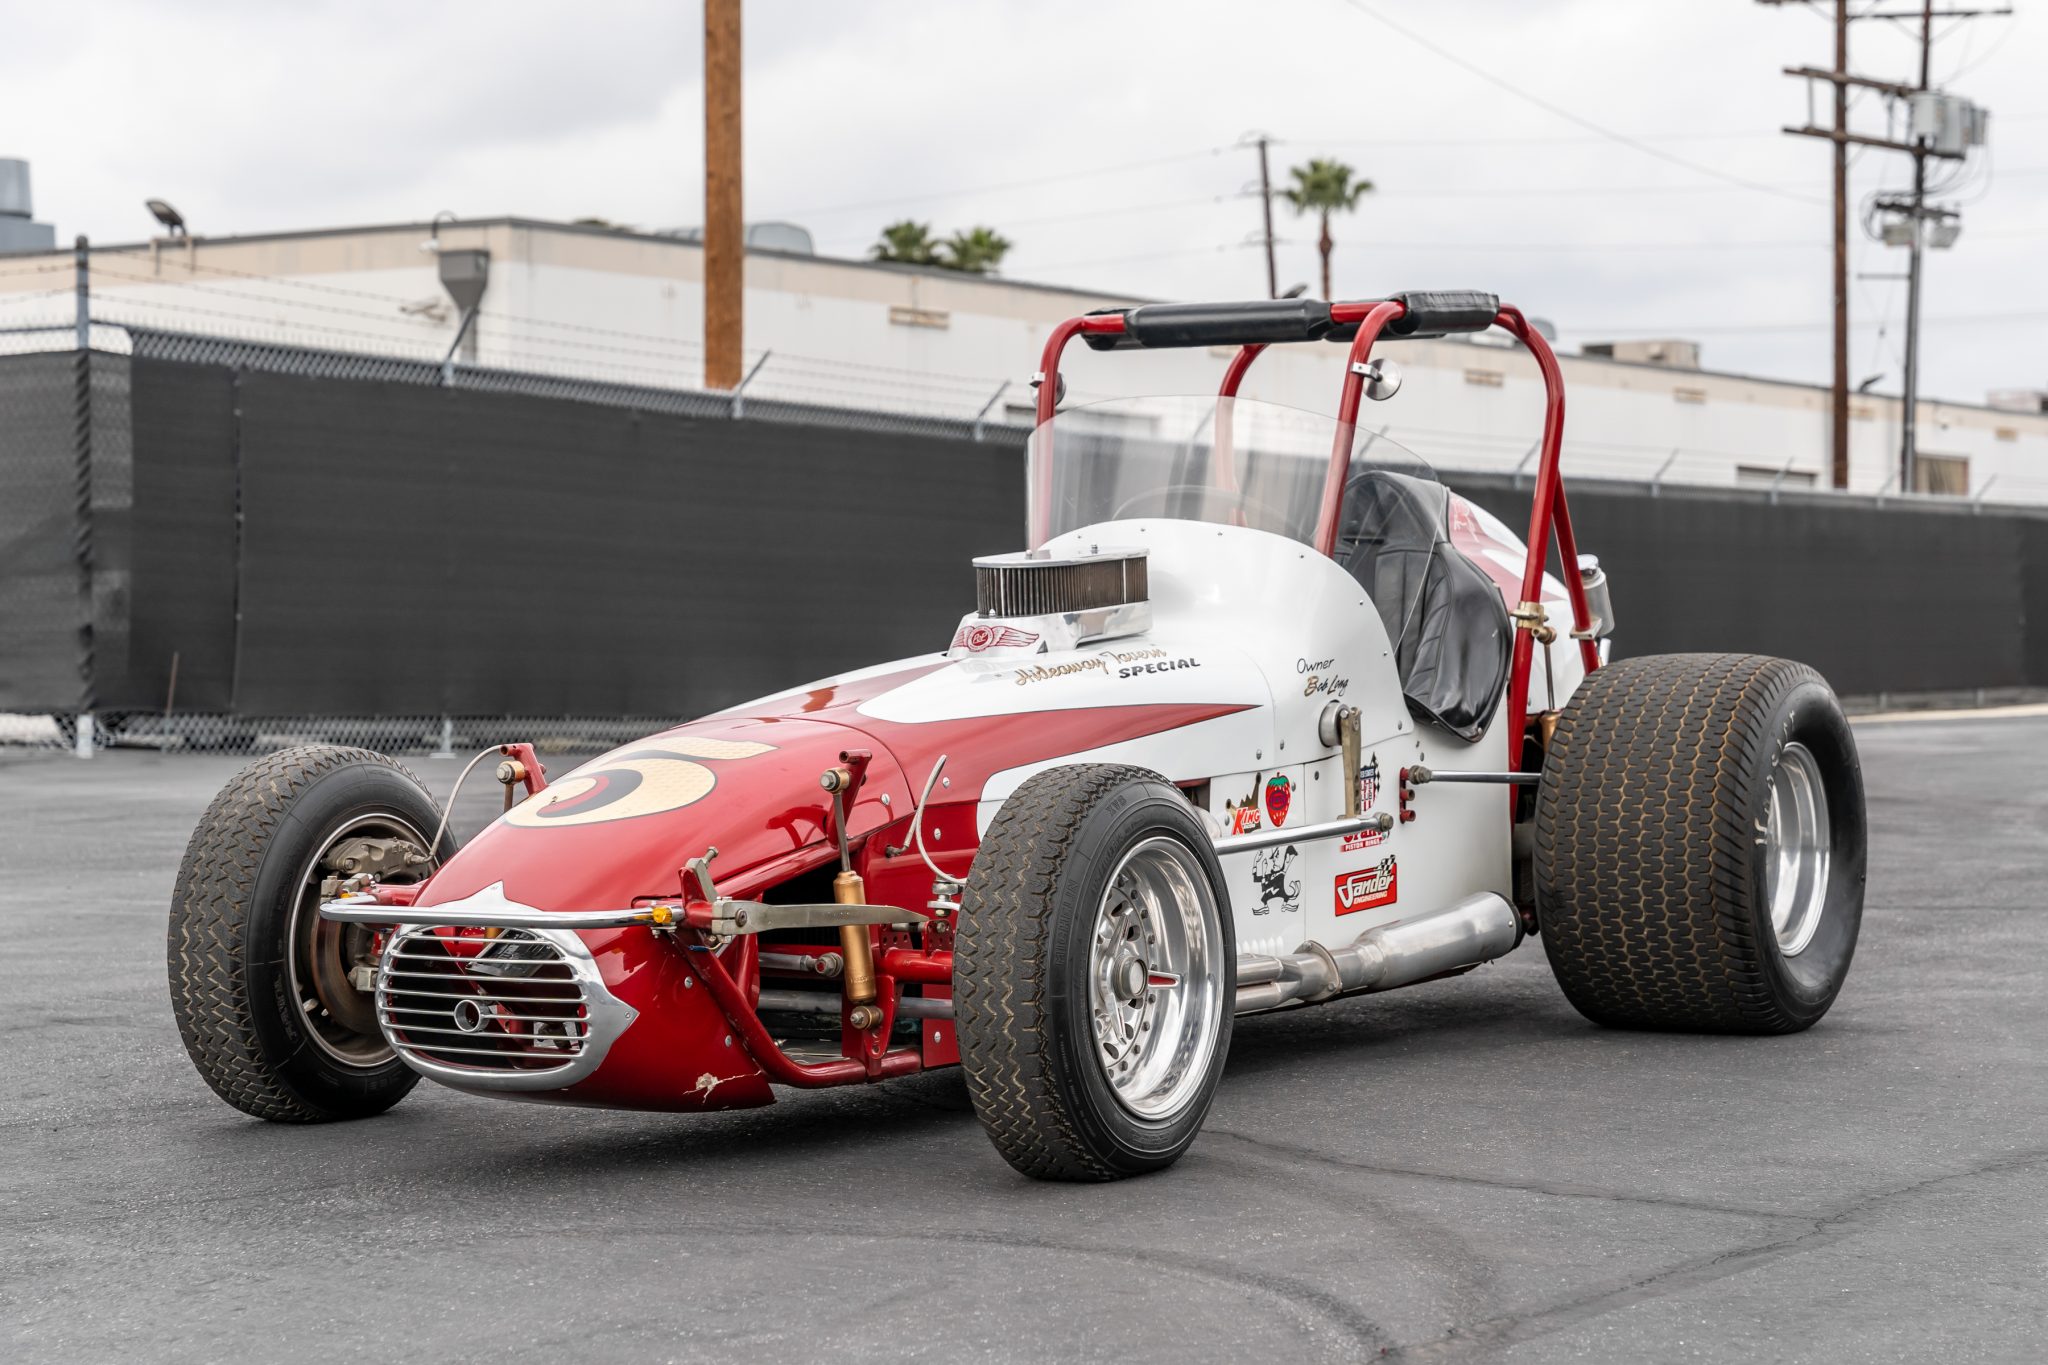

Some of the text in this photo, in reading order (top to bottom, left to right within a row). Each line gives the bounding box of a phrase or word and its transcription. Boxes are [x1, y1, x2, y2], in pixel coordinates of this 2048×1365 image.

[1014, 657, 1109, 686] Hideaway
[1119, 658, 1201, 679] SPECIAL
[1297, 658, 1335, 674] Owner
[1304, 675, 1329, 697] Bob
[1345, 841, 1364, 851] PISTON
[1353, 891, 1388, 905] ENGINEERING
